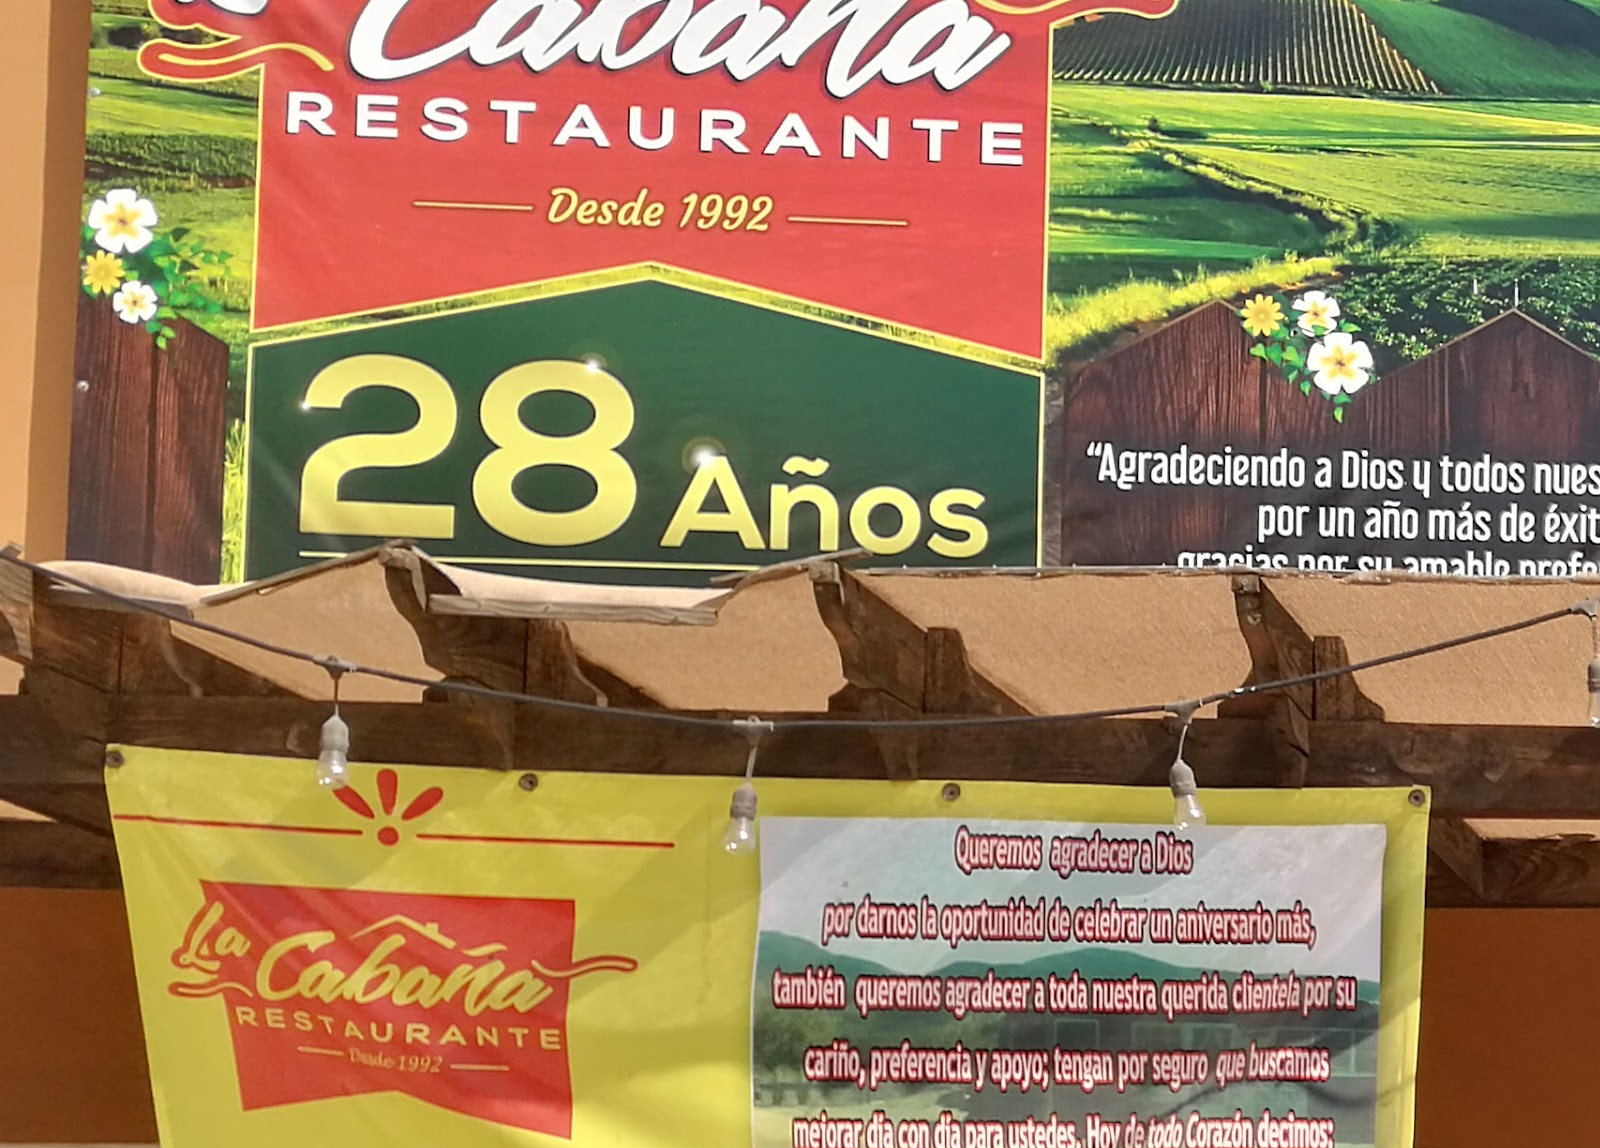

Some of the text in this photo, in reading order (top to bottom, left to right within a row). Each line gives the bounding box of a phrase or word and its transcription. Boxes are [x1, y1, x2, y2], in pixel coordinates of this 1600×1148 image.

[284, 91, 1024, 166] RESTAURANTE
[547, 187, 774, 233] Desde 1992
[299, 352, 989, 560] 28 Años
[1086, 441, 1305, 491] “Agradeciendo
[1315, 455, 1332, 489] a
[1342, 449, 1405, 491] Dios
[1413, 459, 1432, 498] y
[1440, 453, 1525, 494] todos
[1258, 503, 1310, 543] por
[1318, 505, 1355, 538] un
[1364, 499, 1419, 540] año
[1428, 501, 1492, 542] más
[1500, 502, 1535, 543] de
[955, 825, 1193, 878] Queremos agradecer a Dios
[178, 900, 251, 972] La
[822, 894, 1316, 950] por darnos la oportunidad de celebrar un aniversario más,
[255, 929, 554, 1017] Cabaña
[772, 965, 1357, 1022] también queremos agradecer a toda nuestra querida clientela por su
[235, 1005, 562, 1052] RESTAURANTE
[398, 1054, 444, 1073] 1992
[804, 1038, 1330, 1093] cariño, preferencia y apoyo; tengan por seguro que buscamos
